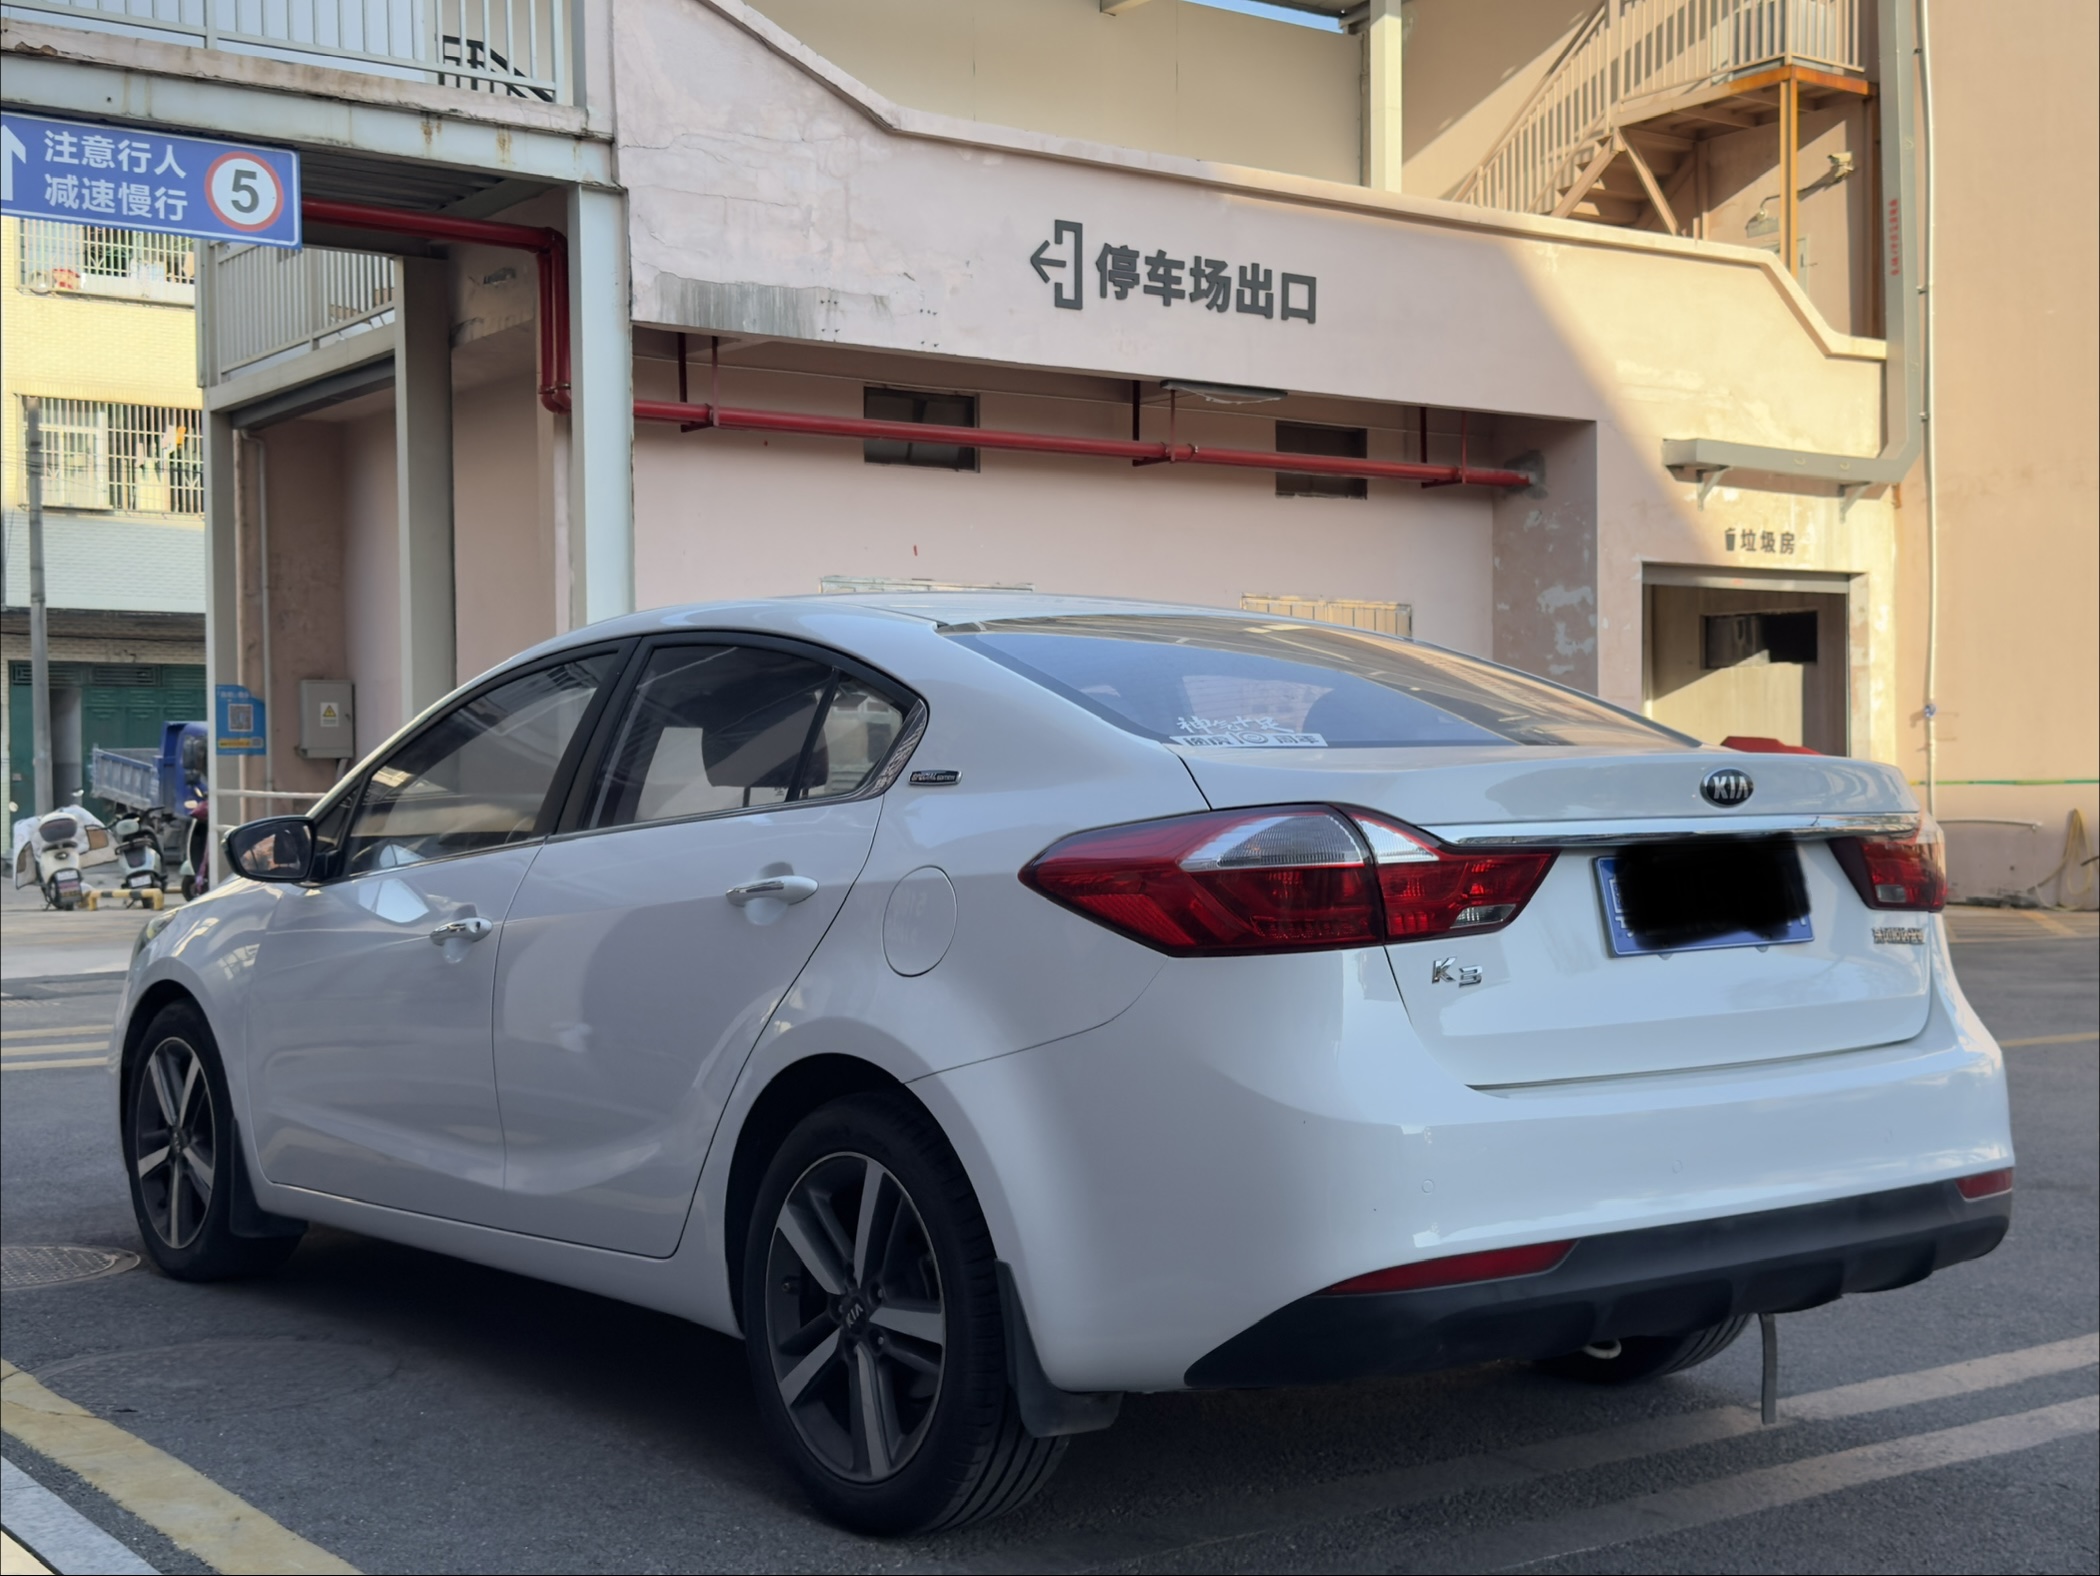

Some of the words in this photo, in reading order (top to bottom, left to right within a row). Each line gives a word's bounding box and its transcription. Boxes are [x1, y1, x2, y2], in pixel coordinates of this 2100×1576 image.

[44, 130, 187, 179] 注意行人
[44, 173, 188, 221] 减速慢行
[231, 169, 259, 214] 5
[1095, 243, 1317, 324] 停车场出口
[1741, 529, 1795, 555] 垃圾房
[1713, 776, 1749, 799] KIA
[1431, 956, 1483, 988] K3
